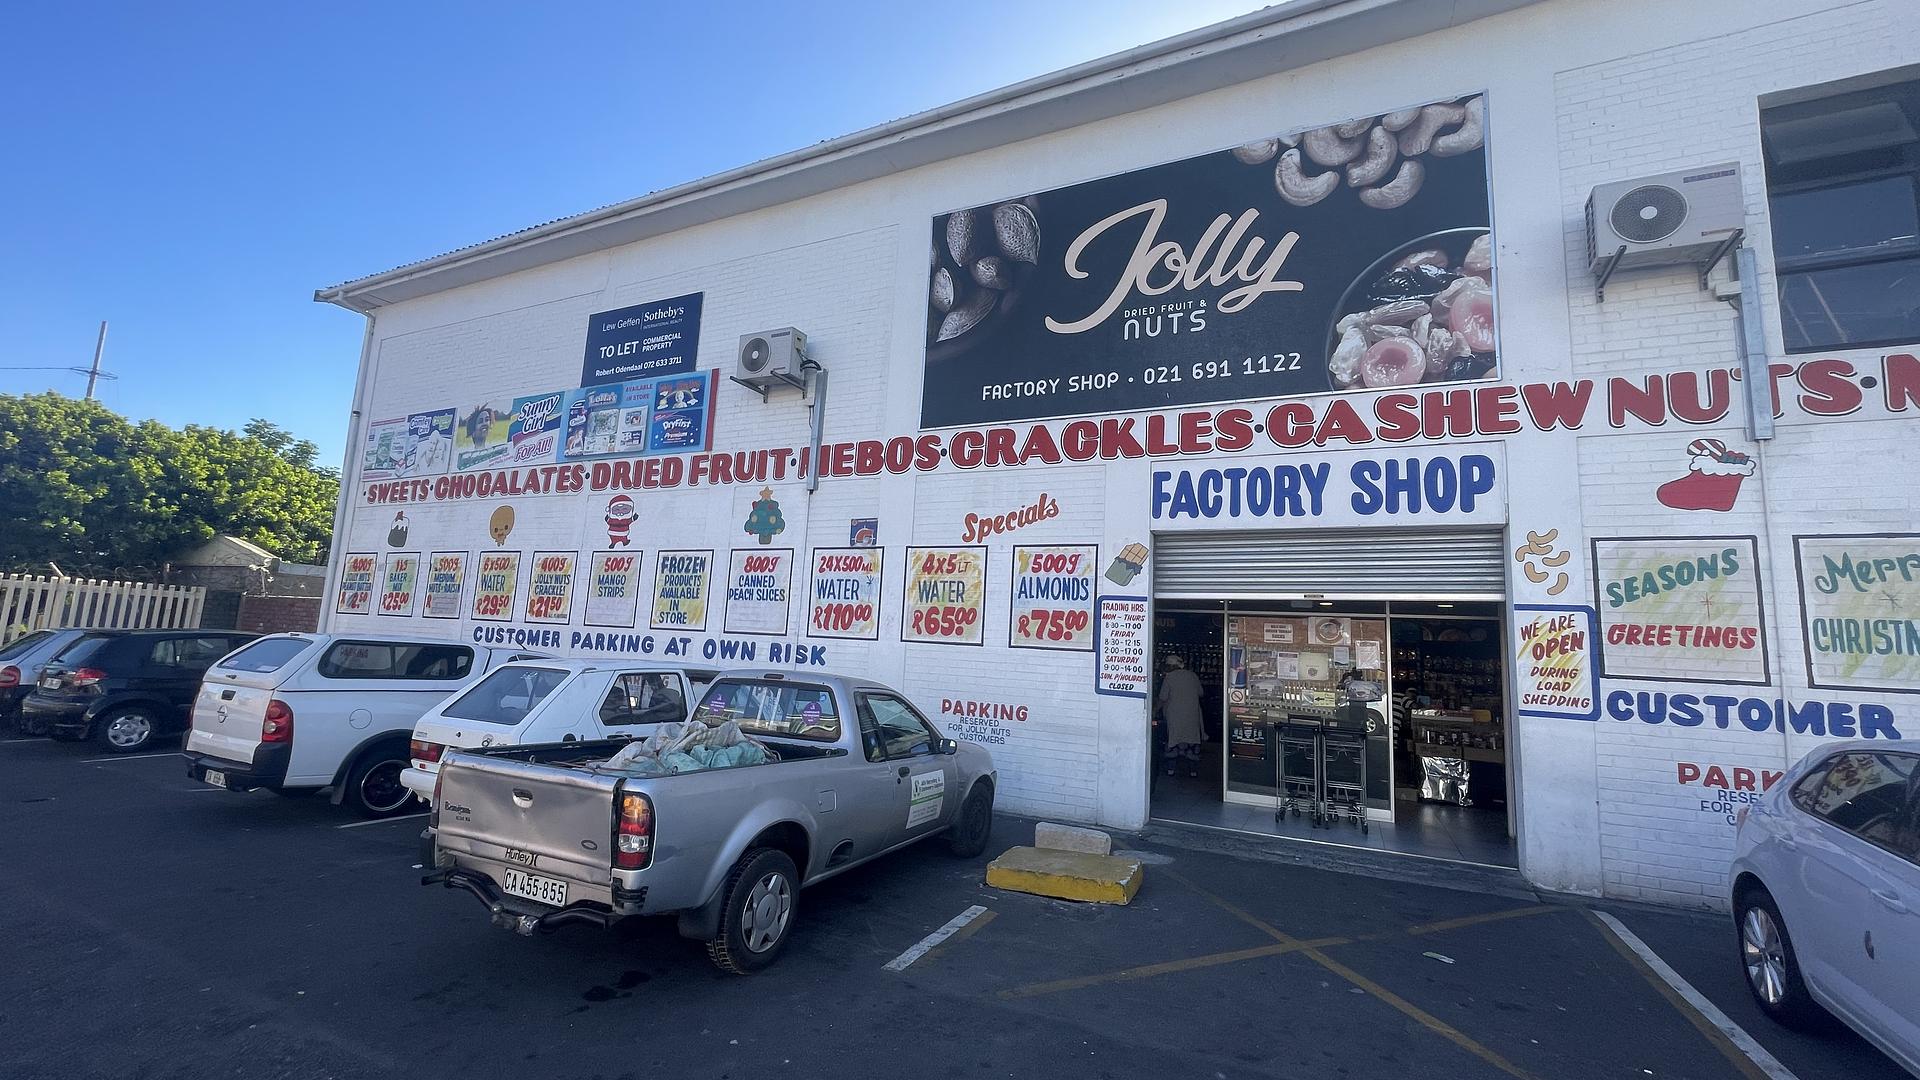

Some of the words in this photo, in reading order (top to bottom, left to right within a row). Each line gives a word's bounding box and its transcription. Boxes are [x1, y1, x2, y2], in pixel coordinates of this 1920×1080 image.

[1045, 198, 1304, 334] Jolly
[1124, 306, 1155, 318] DRIED
[1161, 300, 1193, 313] FRUIT
[1199, 299, 1207, 308] &
[602, 322, 617, 332] Lew
[617, 317, 640, 329] Geffen
[643, 306, 685, 322] Sotheby's
[1123, 309, 1206, 340] NUTS
[641, 341, 673, 352] PROPERTY
[642, 332, 682, 345] COMMERCIAL
[600, 345, 615, 359] TO
[617, 341, 639, 356] LET
[595, 367, 615, 377] Robert
[615, 363, 643, 374] Odendaal
[643, 360, 655, 369] 072
[655, 358, 668, 367] 633
[668, 356, 682, 365] 3711
[982, 378, 1059, 401] FACTORY
[1068, 370, 1120, 393] SHOP
[1144, 365, 1182, 384] 021
[1192, 360, 1231, 380] 691
[1242, 352, 1301, 375] 1122
[518, 394, 560, 421] Sunny
[522, 412, 547, 434] Girl
[367, 478, 430, 504] SWEETS
[590, 456, 683, 491] DRIED
[688, 447, 793, 487] FRUIT
[949, 409, 1254, 470] CRACKLES
[1265, 379, 1594, 449] CASHEW
[1608, 359, 1864, 428] NUTS
[1151, 462, 1331, 519] FACTORY
[1350, 454, 1496, 515] SHOP
[962, 493, 1059, 544] Specials
[540, 557, 568, 572] 400g
[604, 557, 634, 573] 500g
[661, 557, 706, 574] FROZEN
[744, 556, 780, 573] 800g
[1031, 553, 1082, 574] 500g
[389, 572, 408, 582] BAKER
[480, 574, 506, 592] WATER
[534, 574, 554, 584] JOLLY
[553, 574, 571, 585] NUTS
[597, 574, 627, 586] MANGO
[664, 574, 702, 587] PRODUCTS
[739, 575, 775, 588] CANNED
[1607, 548, 1740, 608] SEASONS
[597, 586, 625, 598] STRIPS
[660, 587, 700, 599] AVAILABLE
[728, 588, 754, 601] PEACH
[756, 588, 785, 602] SLICES
[817, 579, 860, 601] WATER
[918, 580, 966, 603] WATER
[1017, 576, 1089, 601] ALMONDS
[669, 599, 680, 611] IN
[1102, 602, 1129, 612] TRADING
[658, 611, 687, 624] STORE
[1102, 612, 1117, 620] MON
[1123, 613, 1145, 622] THURS
[1110, 630, 1136, 638] FRIDAY
[1520, 622, 1540, 641] WE
[1548, 613, 1576, 633] ARE
[1607, 624, 1757, 650] GREETINGS
[473, 626, 560, 648] CUSTOMER
[571, 631, 655, 654] PARKING
[664, 637, 692, 656] AT
[703, 638, 757, 661] OWN
[769, 642, 827, 666] RISK
[1532, 631, 1585, 661] OPEN
[1105, 655, 1140, 664] SATURDAY
[1530, 666, 1579, 679] DURING
[1109, 683, 1134, 691] CLOSED
[1536, 681, 1572, 692] LOAD
[1523, 694, 1591, 708] SHEDDING
[942, 698, 1029, 721] PARKING
[1607, 690, 1902, 739] CUSTOMER
[947, 722, 963, 732] FOR
[966, 725, 987, 734] JOLLY
[990, 727, 1011, 737] NUTS
[960, 716, 1000, 727] RESERVED
[959, 733, 1005, 745] CUSTOMERS
[1700, 800, 1733, 814] FOR
[505, 848, 530, 863] Hurley
[504, 872, 517, 893] CA
[519, 875, 565, 903] 455-855
